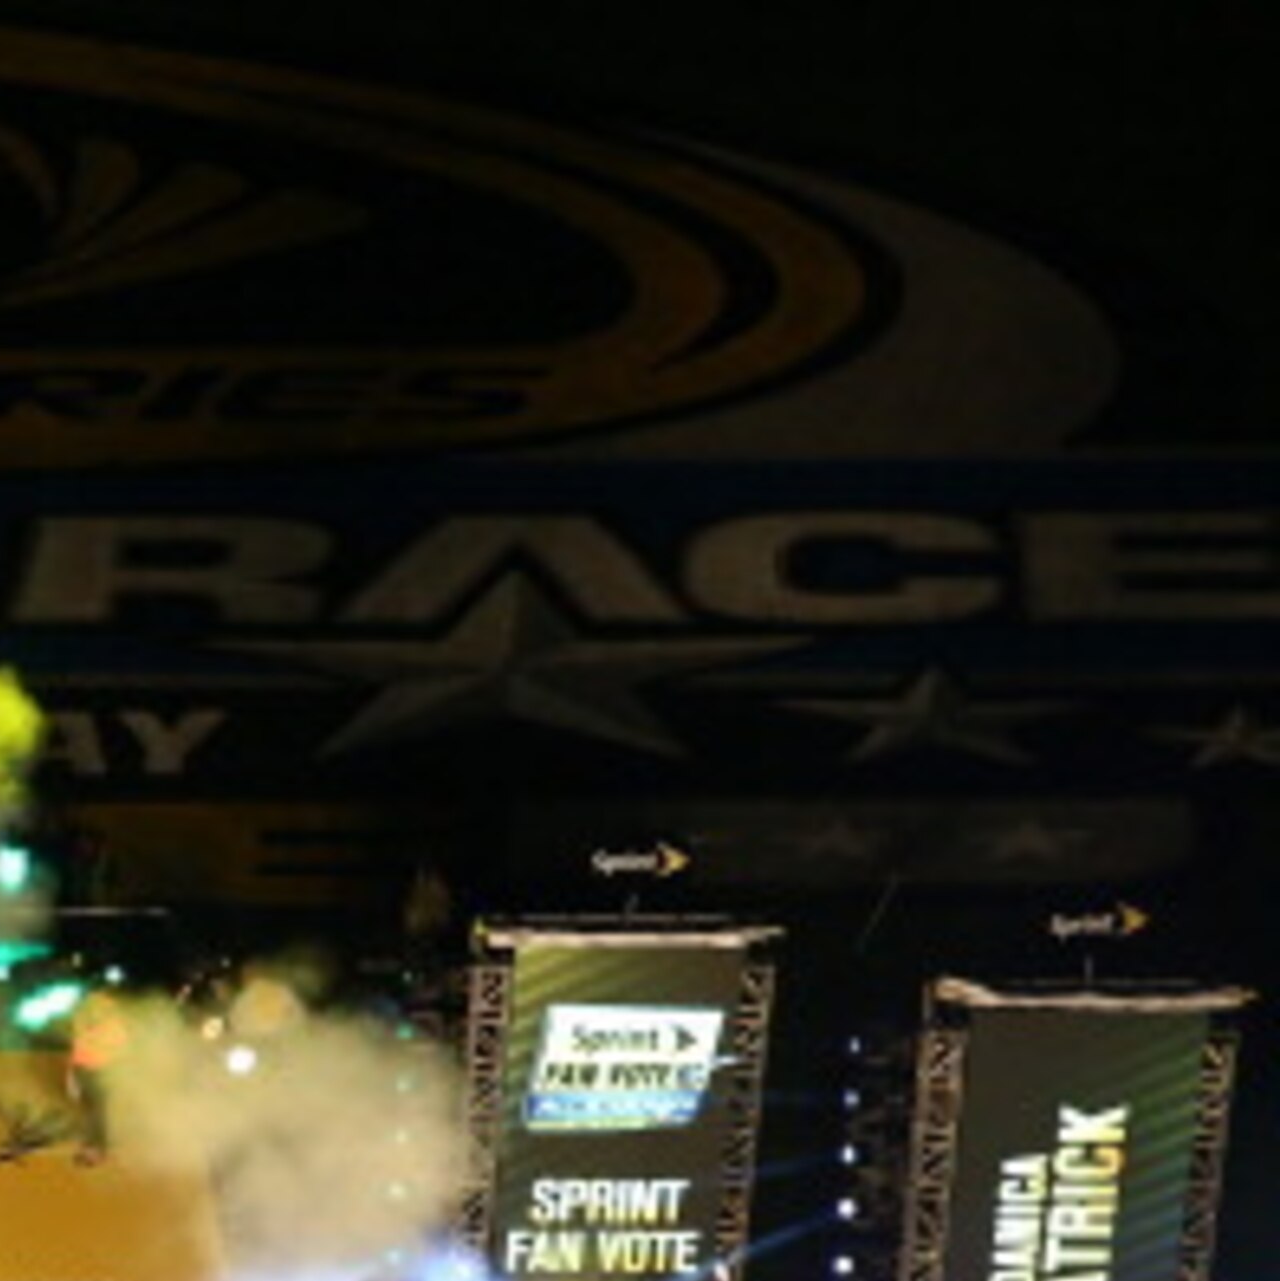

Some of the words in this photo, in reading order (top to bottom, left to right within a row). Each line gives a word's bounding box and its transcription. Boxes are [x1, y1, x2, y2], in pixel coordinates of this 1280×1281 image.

[5, 506, 1280, 626] RACE
[530, 1178, 691, 1223] SPRINT
[504, 1231, 582, 1274] FAN
[597, 1231, 702, 1274] VOTE
